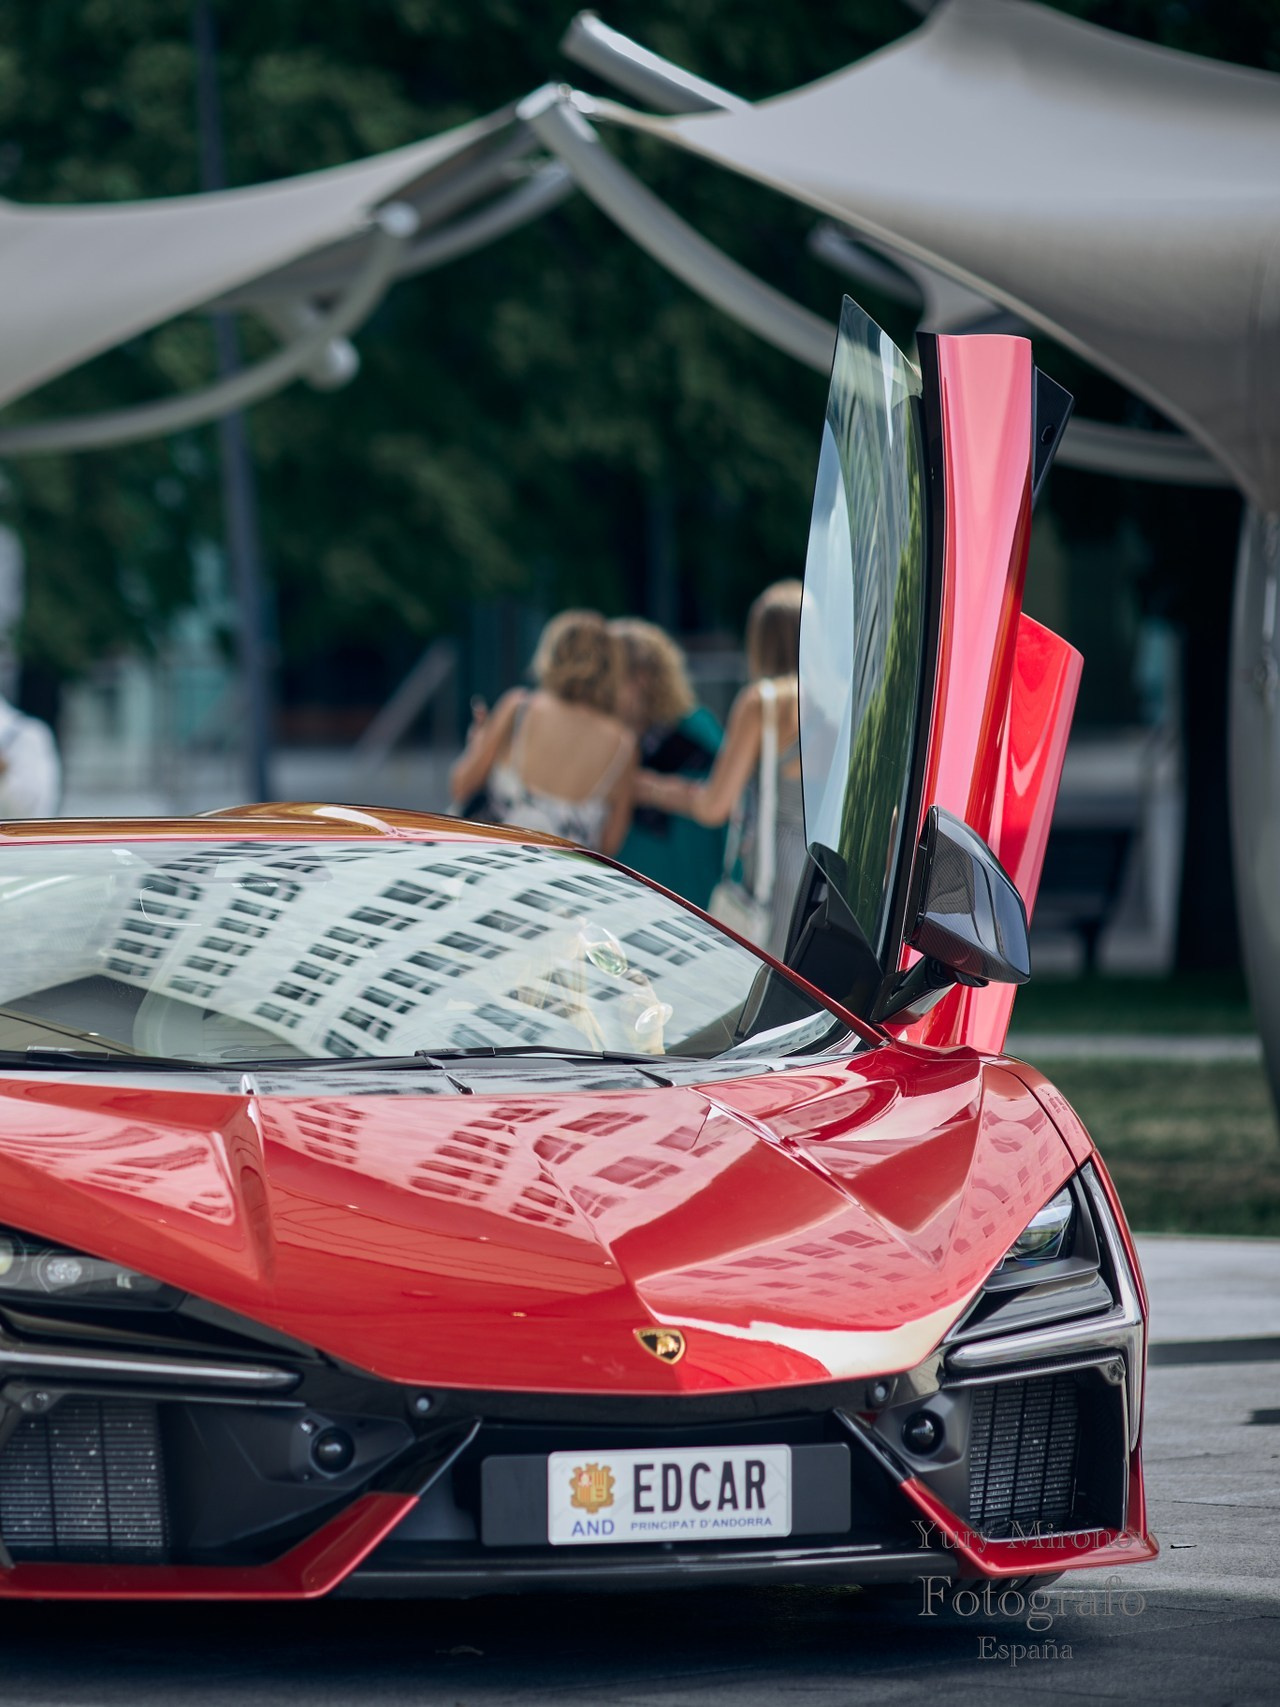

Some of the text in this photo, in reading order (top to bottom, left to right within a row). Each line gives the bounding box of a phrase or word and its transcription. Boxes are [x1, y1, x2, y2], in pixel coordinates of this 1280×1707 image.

[632, 1459, 766, 1514] EDCAR
[571, 1518, 615, 1537] AND
[630, 1516, 773, 1532] PRINCIPAT D'ANDORRA
